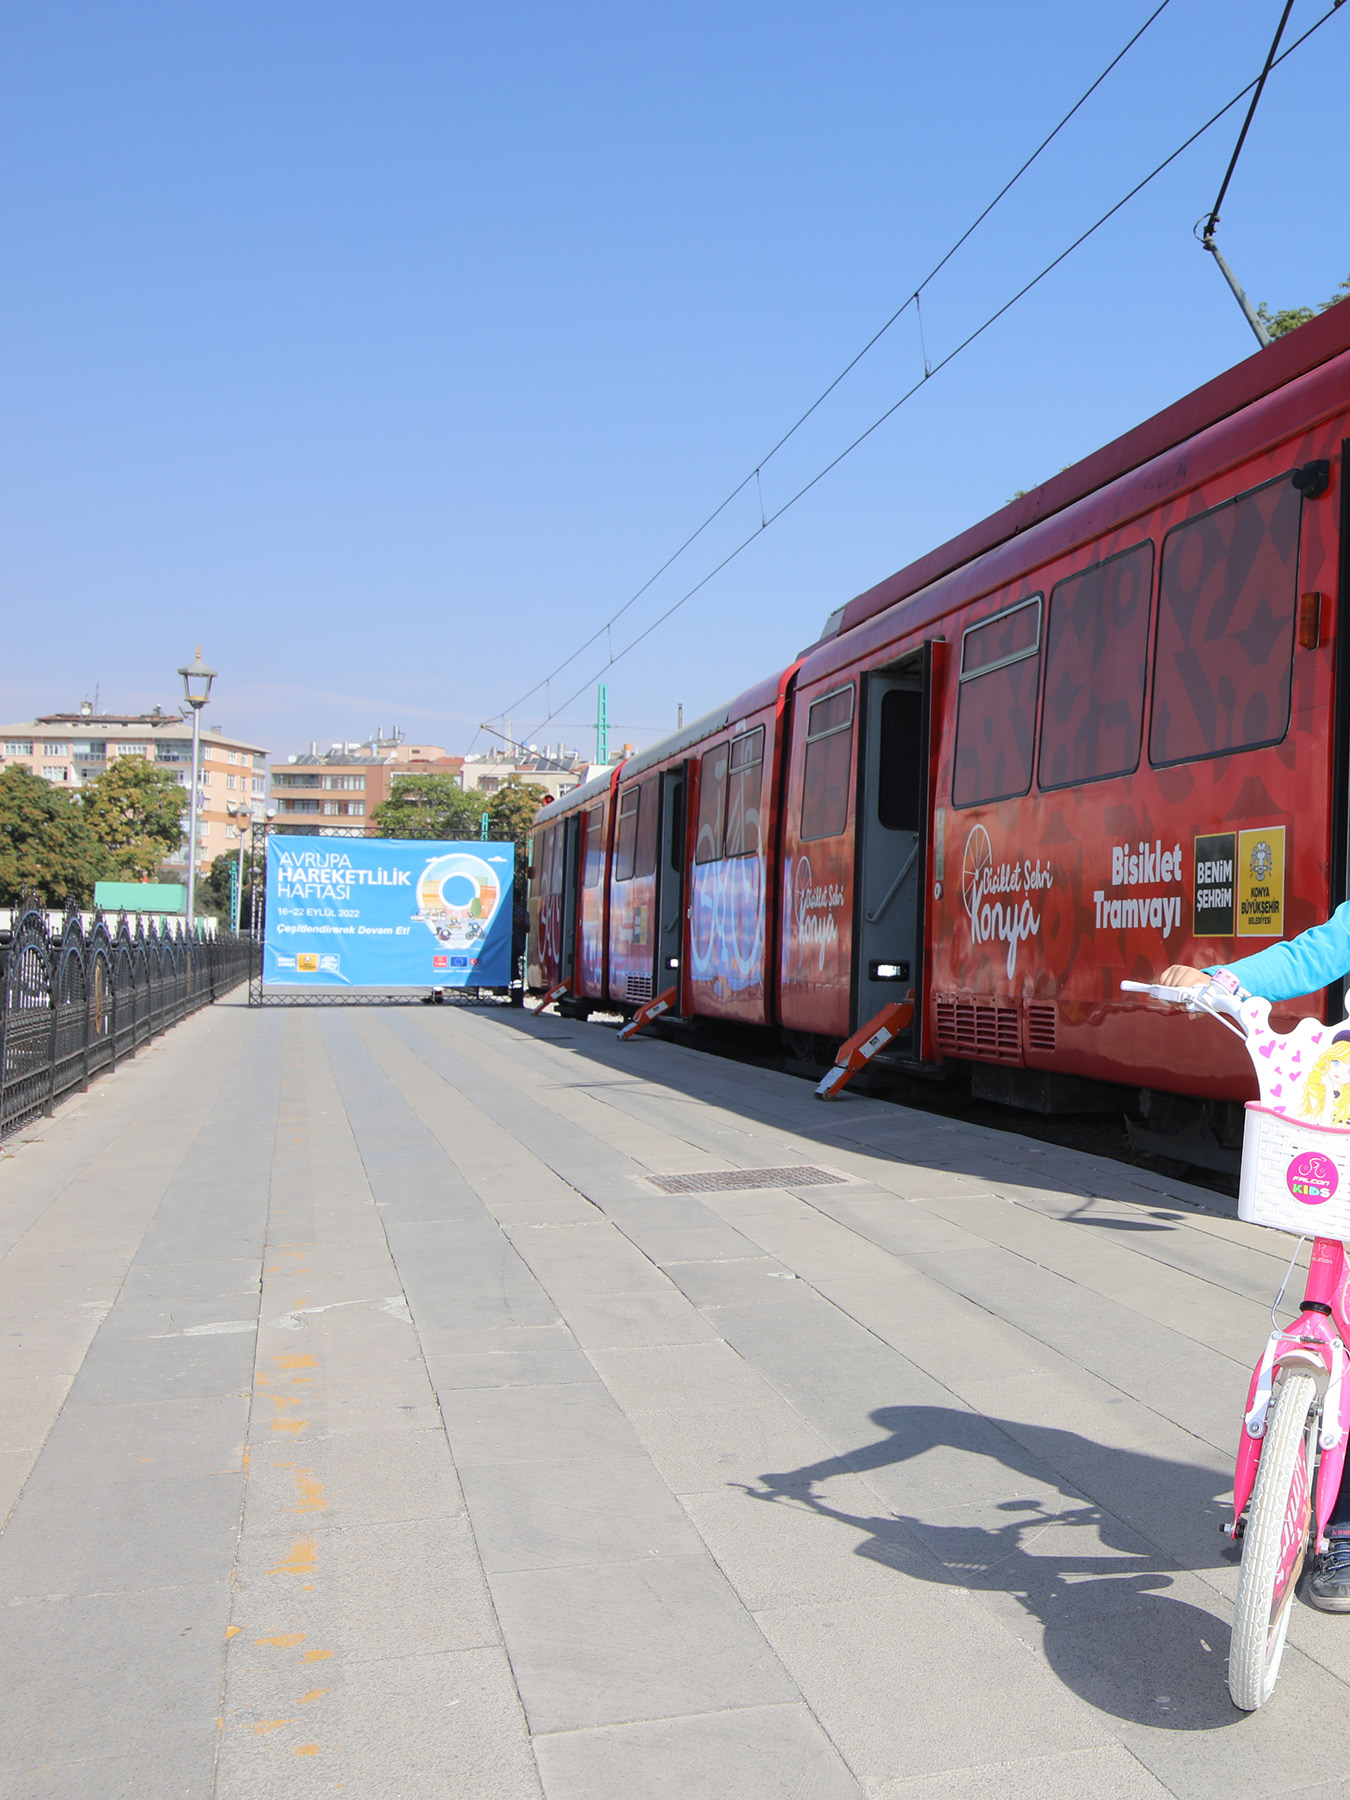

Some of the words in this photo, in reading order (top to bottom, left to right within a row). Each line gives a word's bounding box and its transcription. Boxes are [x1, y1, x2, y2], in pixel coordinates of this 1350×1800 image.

[278, 851, 353, 869] AVRUPA
[1112, 839, 1183, 886] Bisiklet
[277, 866, 412, 887] HAREKETLİLİK
[1197, 859, 1233, 885] BENİM
[276, 882, 351, 900] HAFTASI
[1196, 887, 1233, 913] ŞEHRİM
[1250, 886, 1270, 898] KONYA
[306, 907, 337, 917] EYLÜL
[338, 908, 361, 918] 2022
[1093, 890, 1181, 939] Tramvayı
[357, 925, 394, 935] Devam
[395, 926, 411, 936] Et!
[970, 878, 1040, 980] Konya
[1292, 1183, 1331, 1198] KIDS
